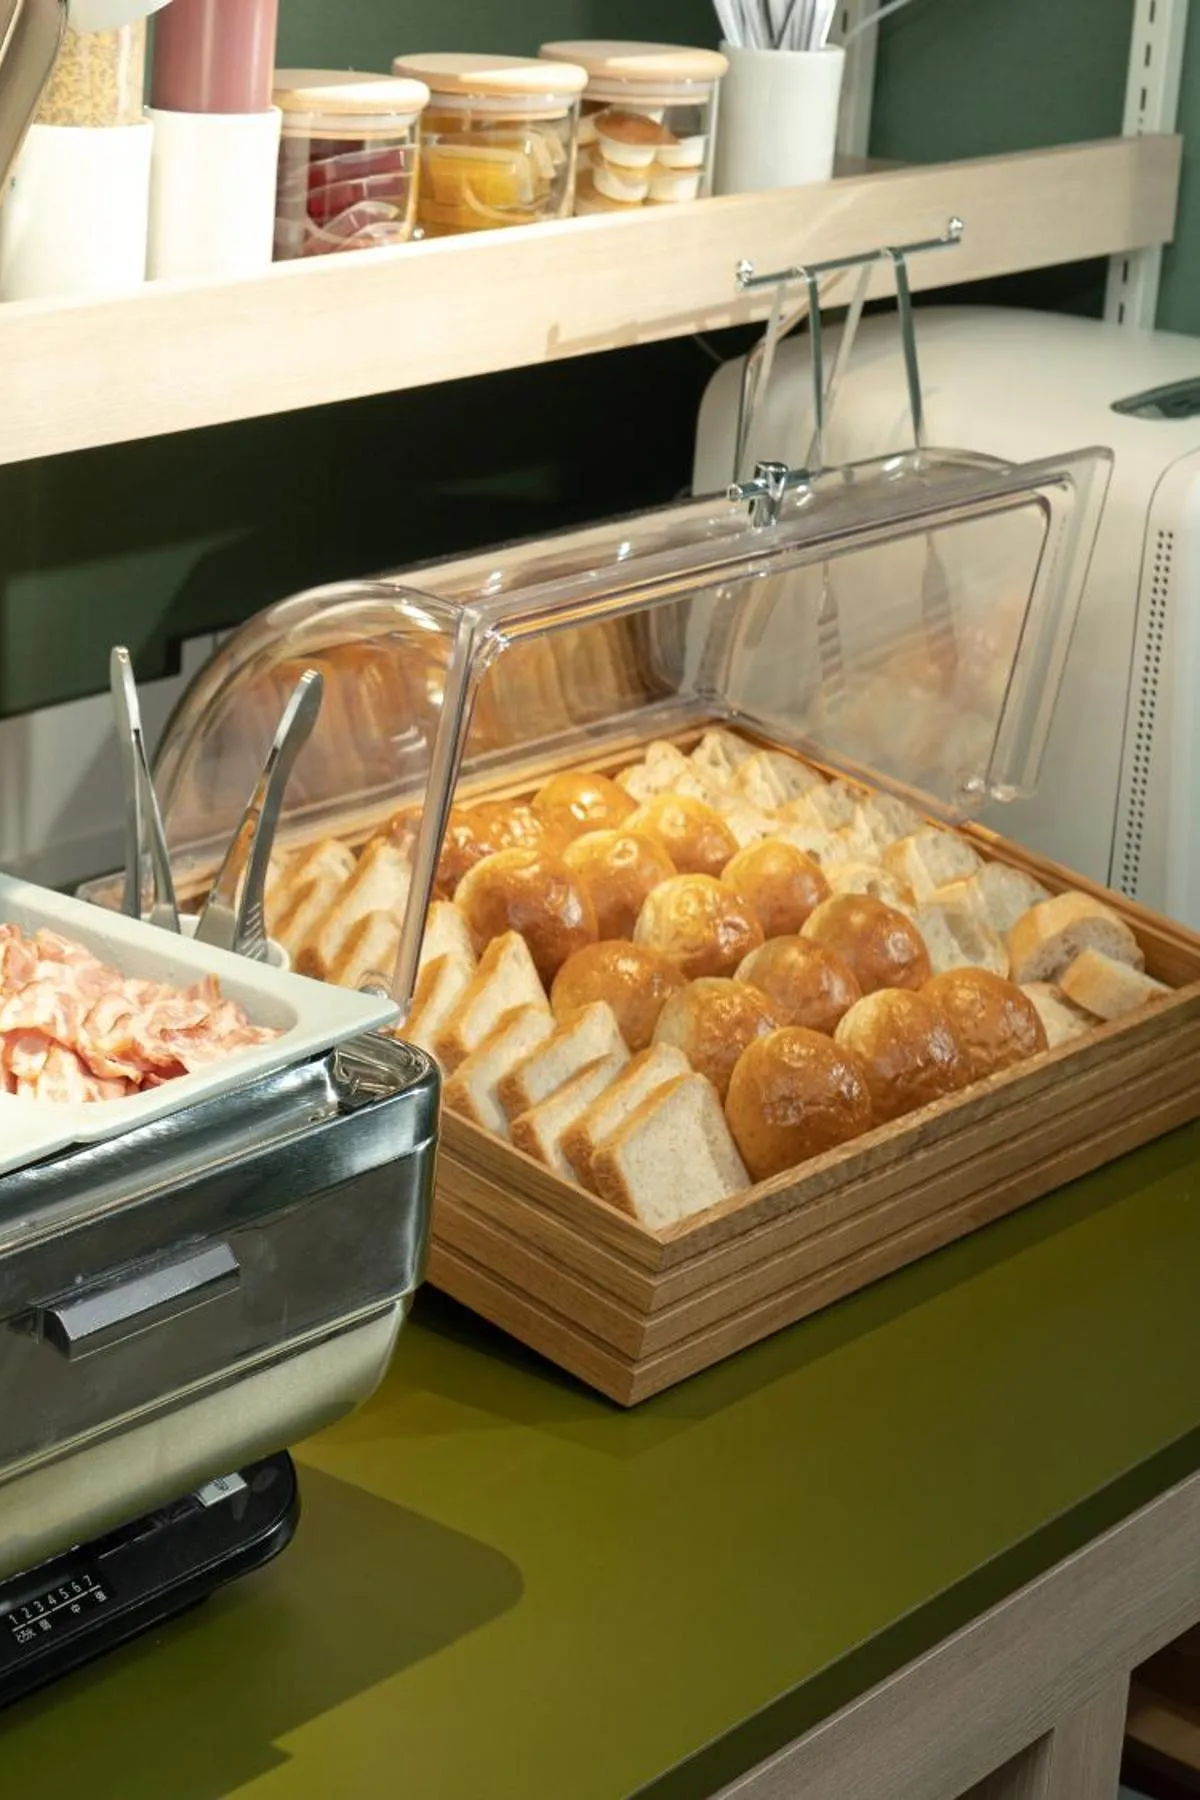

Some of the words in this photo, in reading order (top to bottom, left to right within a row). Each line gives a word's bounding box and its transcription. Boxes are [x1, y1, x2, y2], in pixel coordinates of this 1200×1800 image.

[9, 1614, 18, 1624] 1
[21, 1607, 32, 1619] 2
[33, 1601, 44, 1612] 3
[47, 1594, 57, 1604] 4
[59, 1588, 69, 1599] 5
[71, 1582, 81, 1592] 6
[83, 1575, 92, 1585] 7
